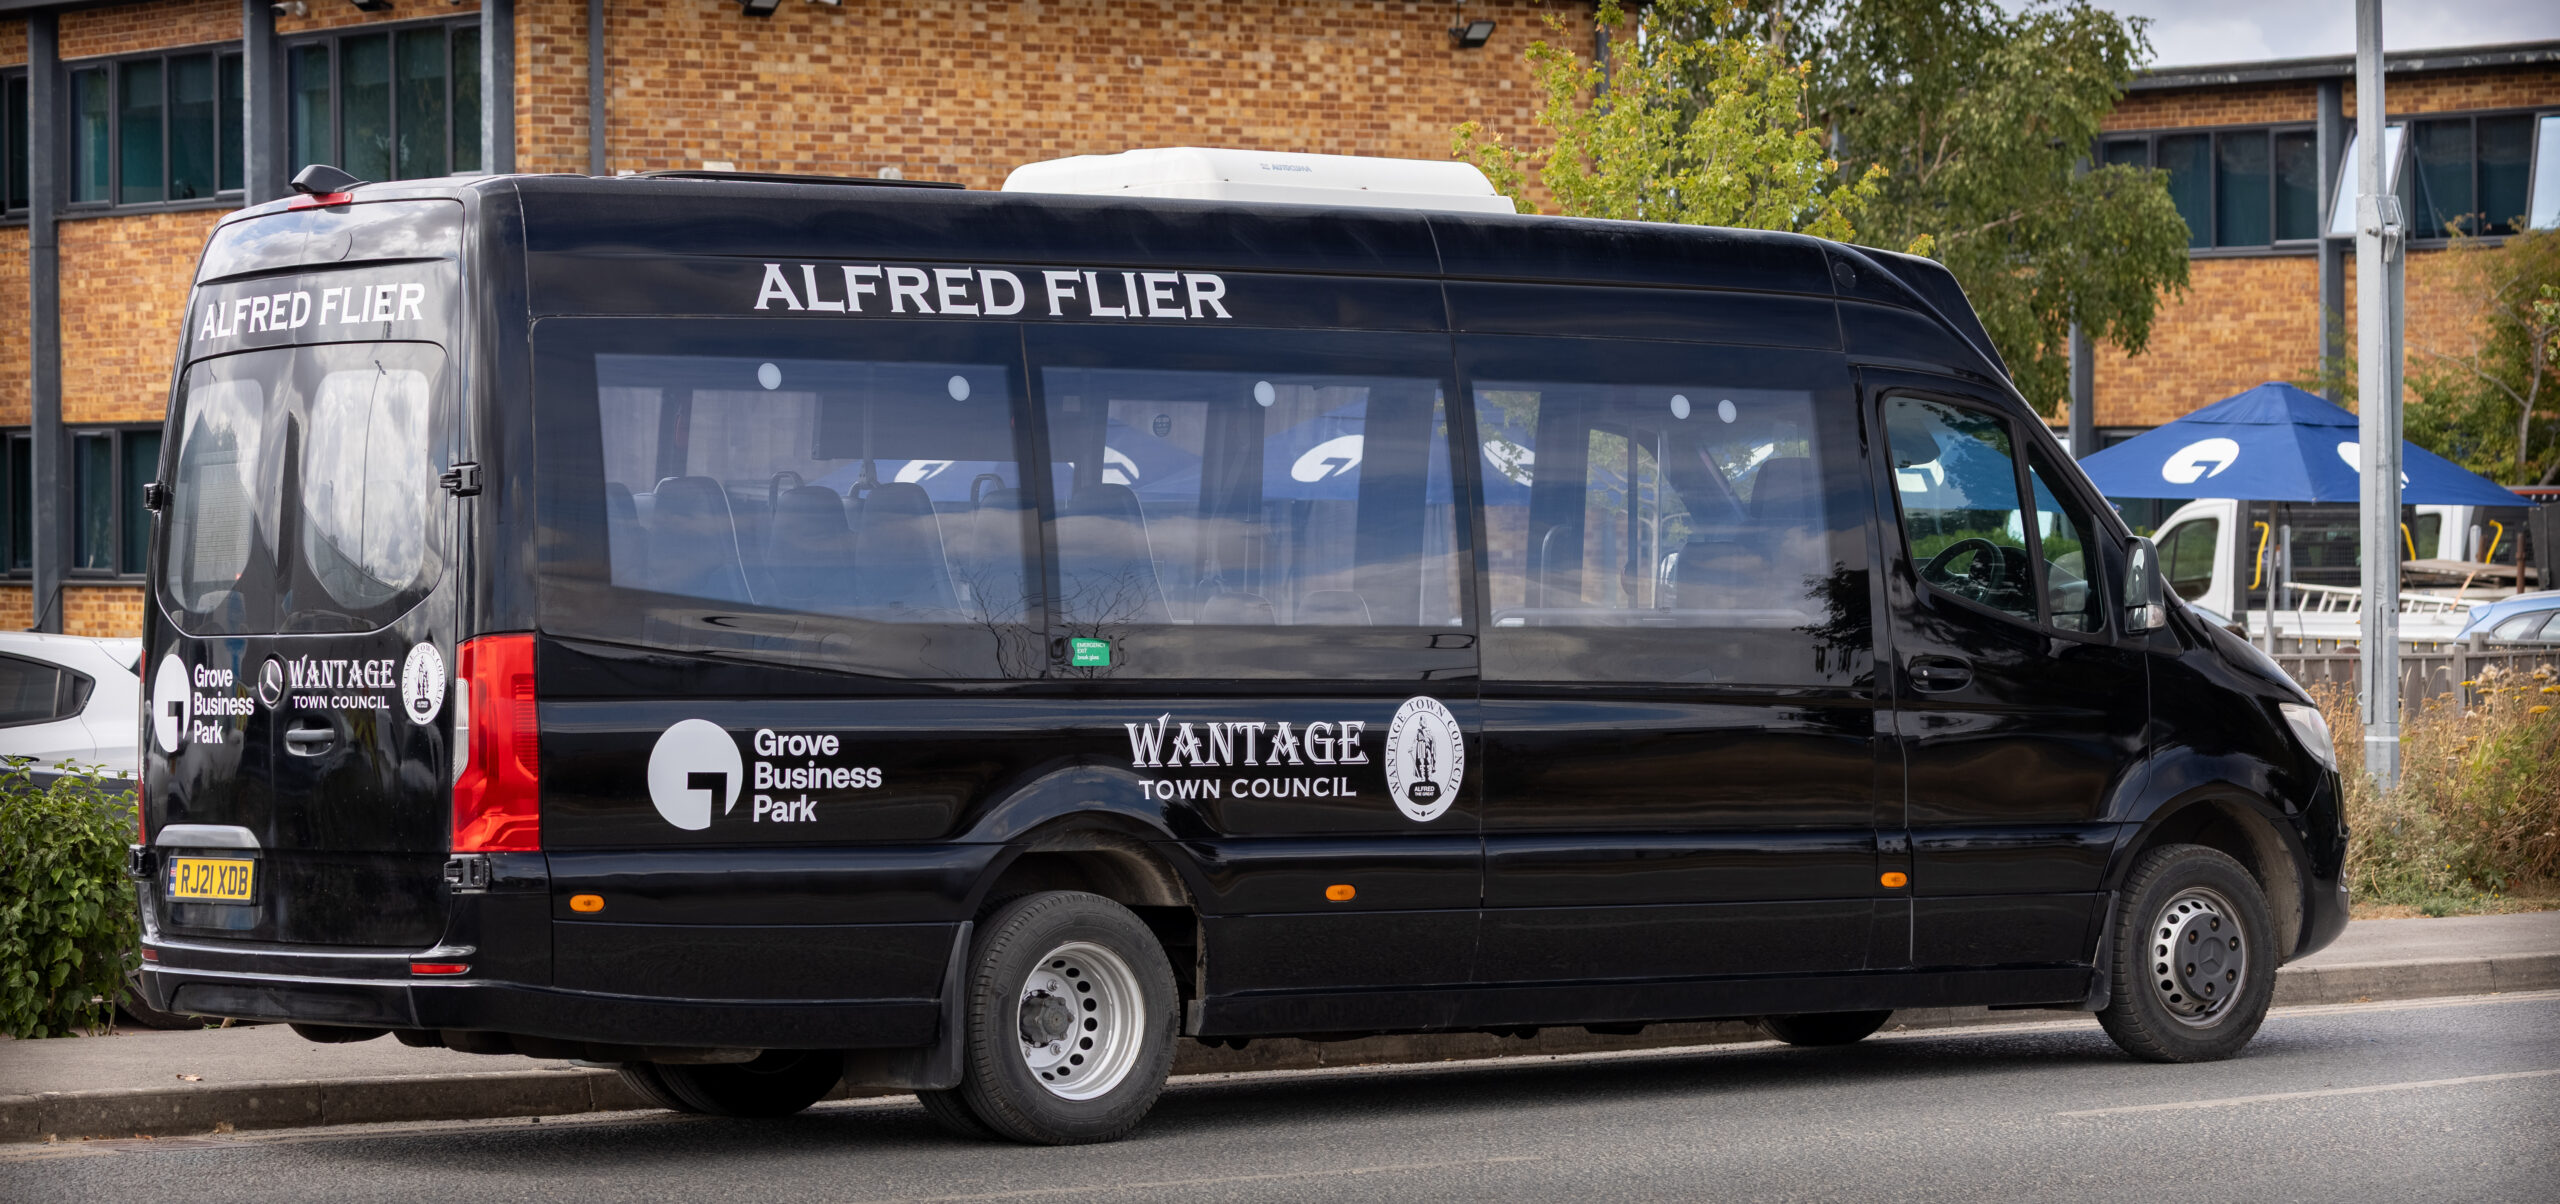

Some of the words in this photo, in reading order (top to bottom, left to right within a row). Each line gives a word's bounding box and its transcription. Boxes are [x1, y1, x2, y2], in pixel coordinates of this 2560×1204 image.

[754, 263, 1026, 316] ALFRED
[1042, 269, 1232, 320] FLIER
[199, 291, 311, 341] ALFRED
[319, 283, 425, 325] FLIER
[194, 664, 233, 688] Grove
[288, 653, 396, 688] WANTAGE
[194, 691, 254, 716] Business
[293, 696, 328, 708] TOWN
[331, 696, 389, 708] COUNCIL
[194, 720, 223, 744] Park
[754, 728, 839, 756] Grove
[1124, 712, 1370, 768] WANTAGE
[1387, 713, 1406, 794] WANTAGE
[1407, 699, 1446, 717] TOWN
[1447, 720, 1463, 792] COUNCIL
[754, 760, 882, 789] Business
[1138, 779, 1221, 800] TOWN
[1231, 777, 1357, 798] COUNCIL
[753, 794, 817, 823] Park
[181, 864, 214, 894] RJ21
[217, 865, 248, 896] XDB
